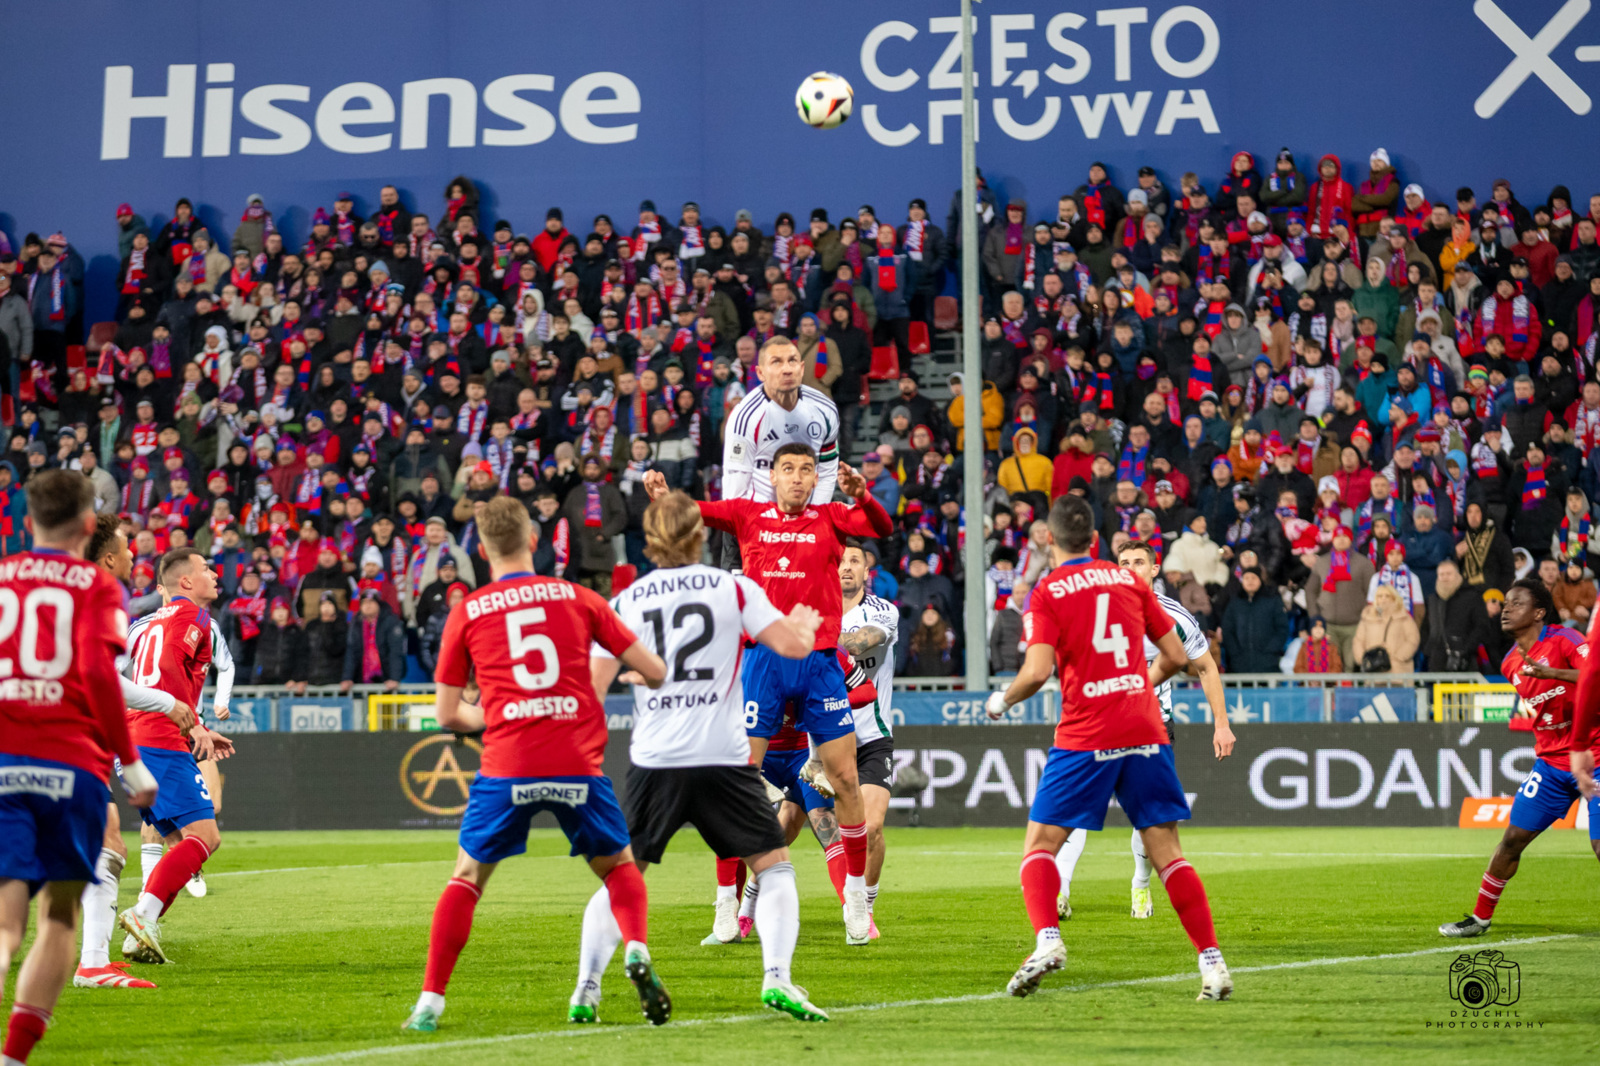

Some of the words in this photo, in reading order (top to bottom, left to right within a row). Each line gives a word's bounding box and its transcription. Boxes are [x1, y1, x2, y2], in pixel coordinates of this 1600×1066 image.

[860, 5, 1221, 98] CZĘSTO
[100, 63, 641, 160] Hisense
[758, 529, 816, 543] Hisense
[17, 557, 97, 590] CARLOS
[632, 574, 721, 602] PANKOV
[1048, 568, 1135, 598] SVARNAS
[465, 582, 576, 620] BERGGREN
[642, 602, 715, 682] 12
[1092, 593, 1130, 669] 4
[505, 607, 560, 691] 5
[503, 696, 580, 720] ONESTO
[743, 700, 759, 729] 8
[517, 786, 584, 800] NEONET
